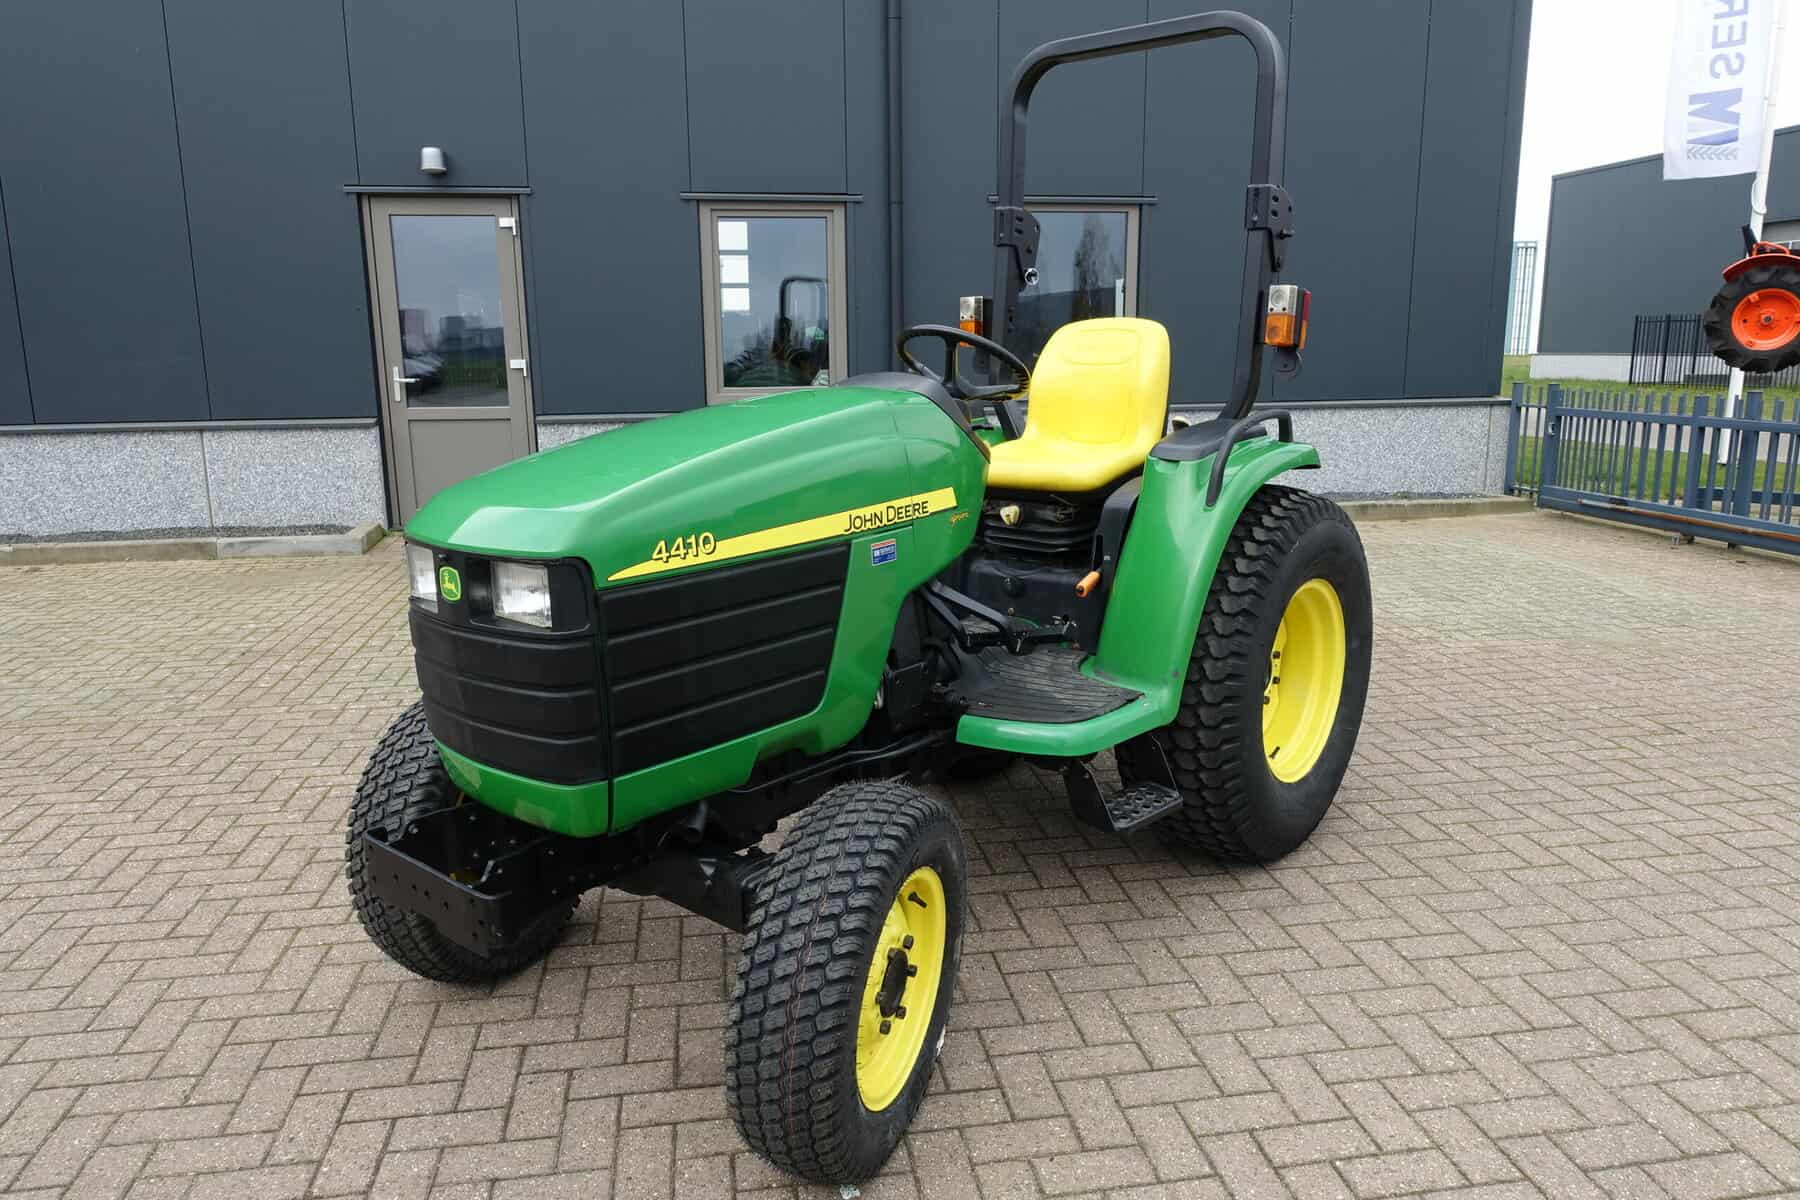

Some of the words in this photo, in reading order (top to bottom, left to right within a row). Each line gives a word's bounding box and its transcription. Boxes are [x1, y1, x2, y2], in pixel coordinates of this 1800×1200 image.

[844, 510, 883, 532] JOHN
[886, 500, 929, 523] DEERE
[651, 531, 716, 565] 4410
